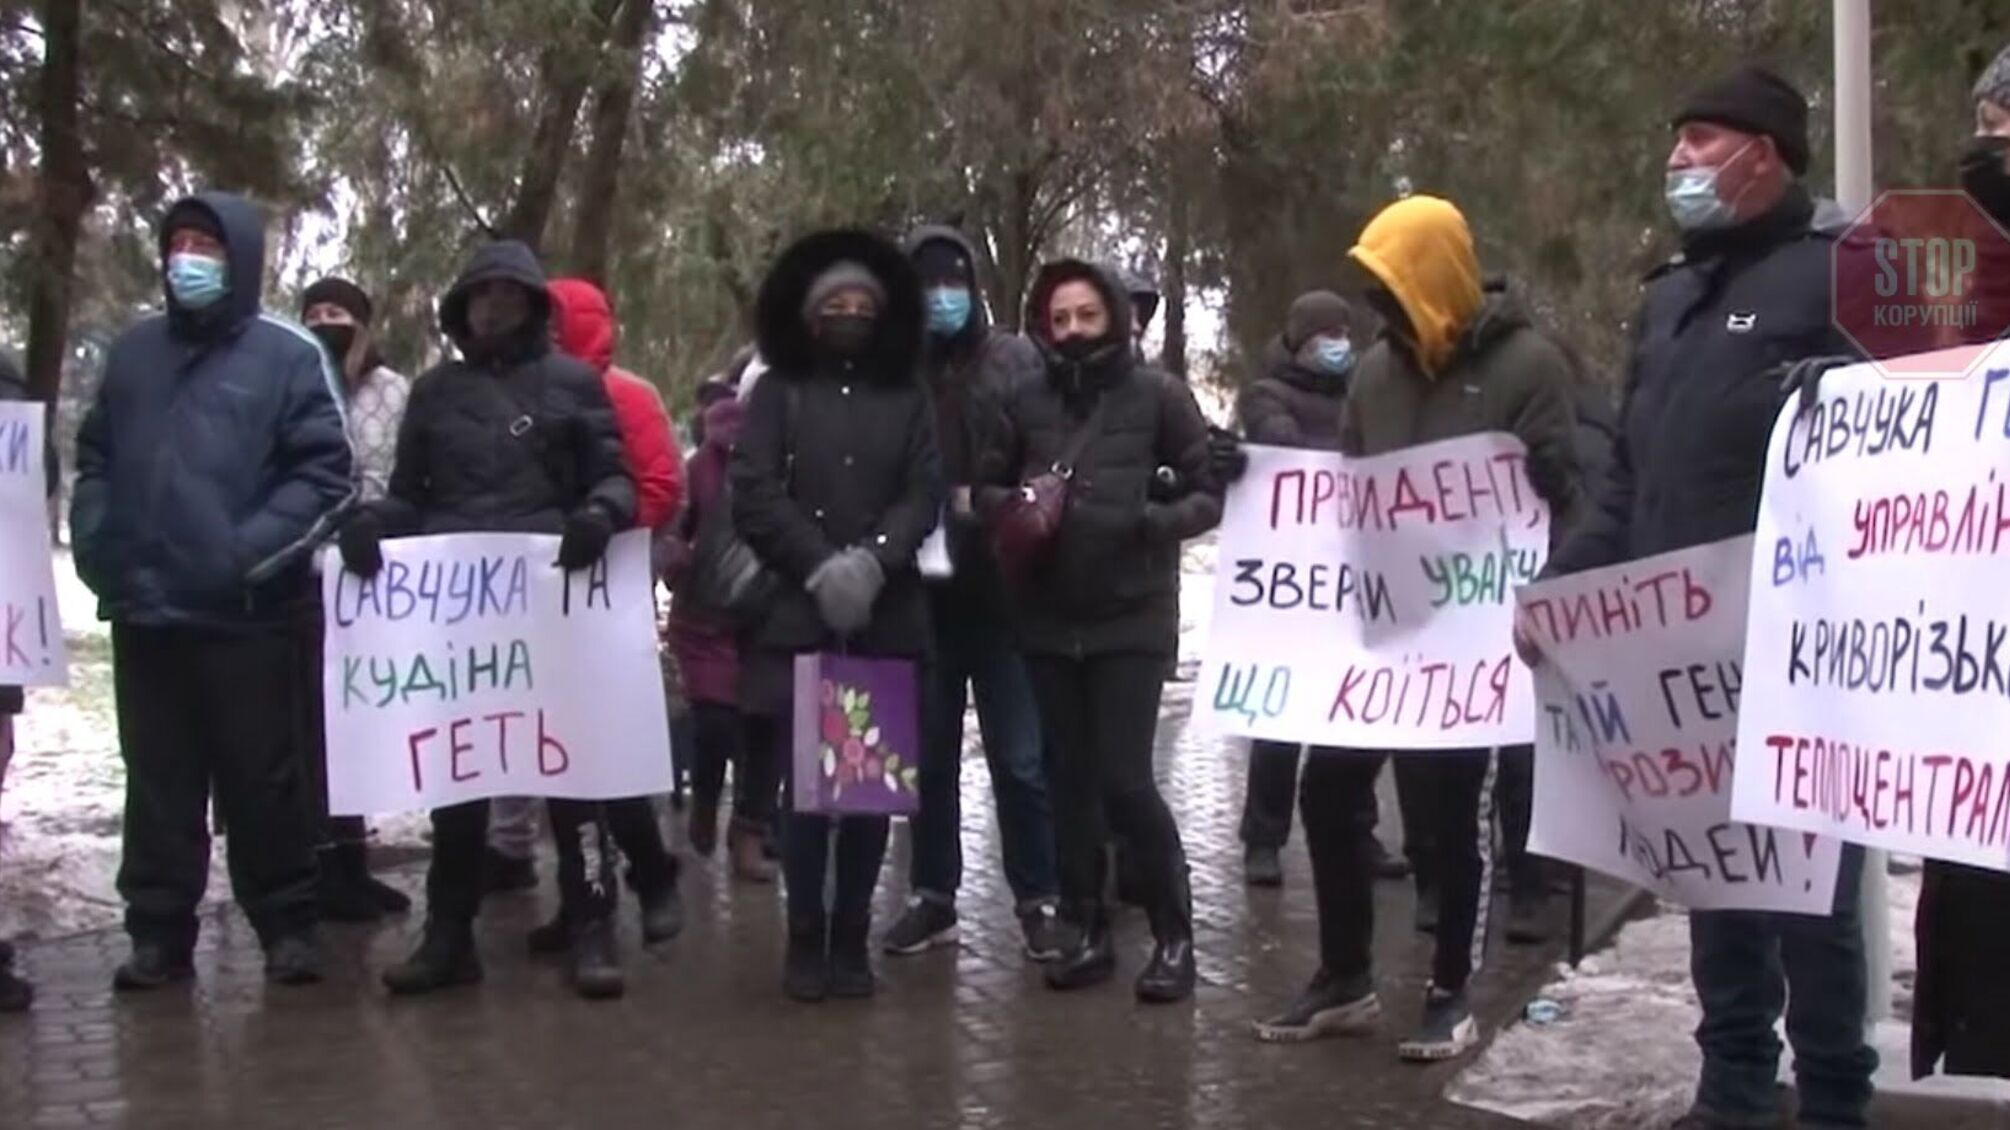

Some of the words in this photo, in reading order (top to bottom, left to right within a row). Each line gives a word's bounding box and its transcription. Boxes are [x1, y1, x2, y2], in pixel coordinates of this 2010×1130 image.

[1782, 381, 1938, 478] САВЧУКА
[1975, 368, 2010, 442] Г
[1772, 512, 1825, 587] ВІД
[336, 556, 528, 627] САВЧУКА
[342, 640, 534, 711] КУДІНА
[1788, 599, 2010, 695] КРИВОРІЗЬК
[1213, 662, 1292, 726] ЩО
[1328, 653, 1512, 731] КОЇТЬСЯ
[407, 708, 571, 792] ГЕТЬ
